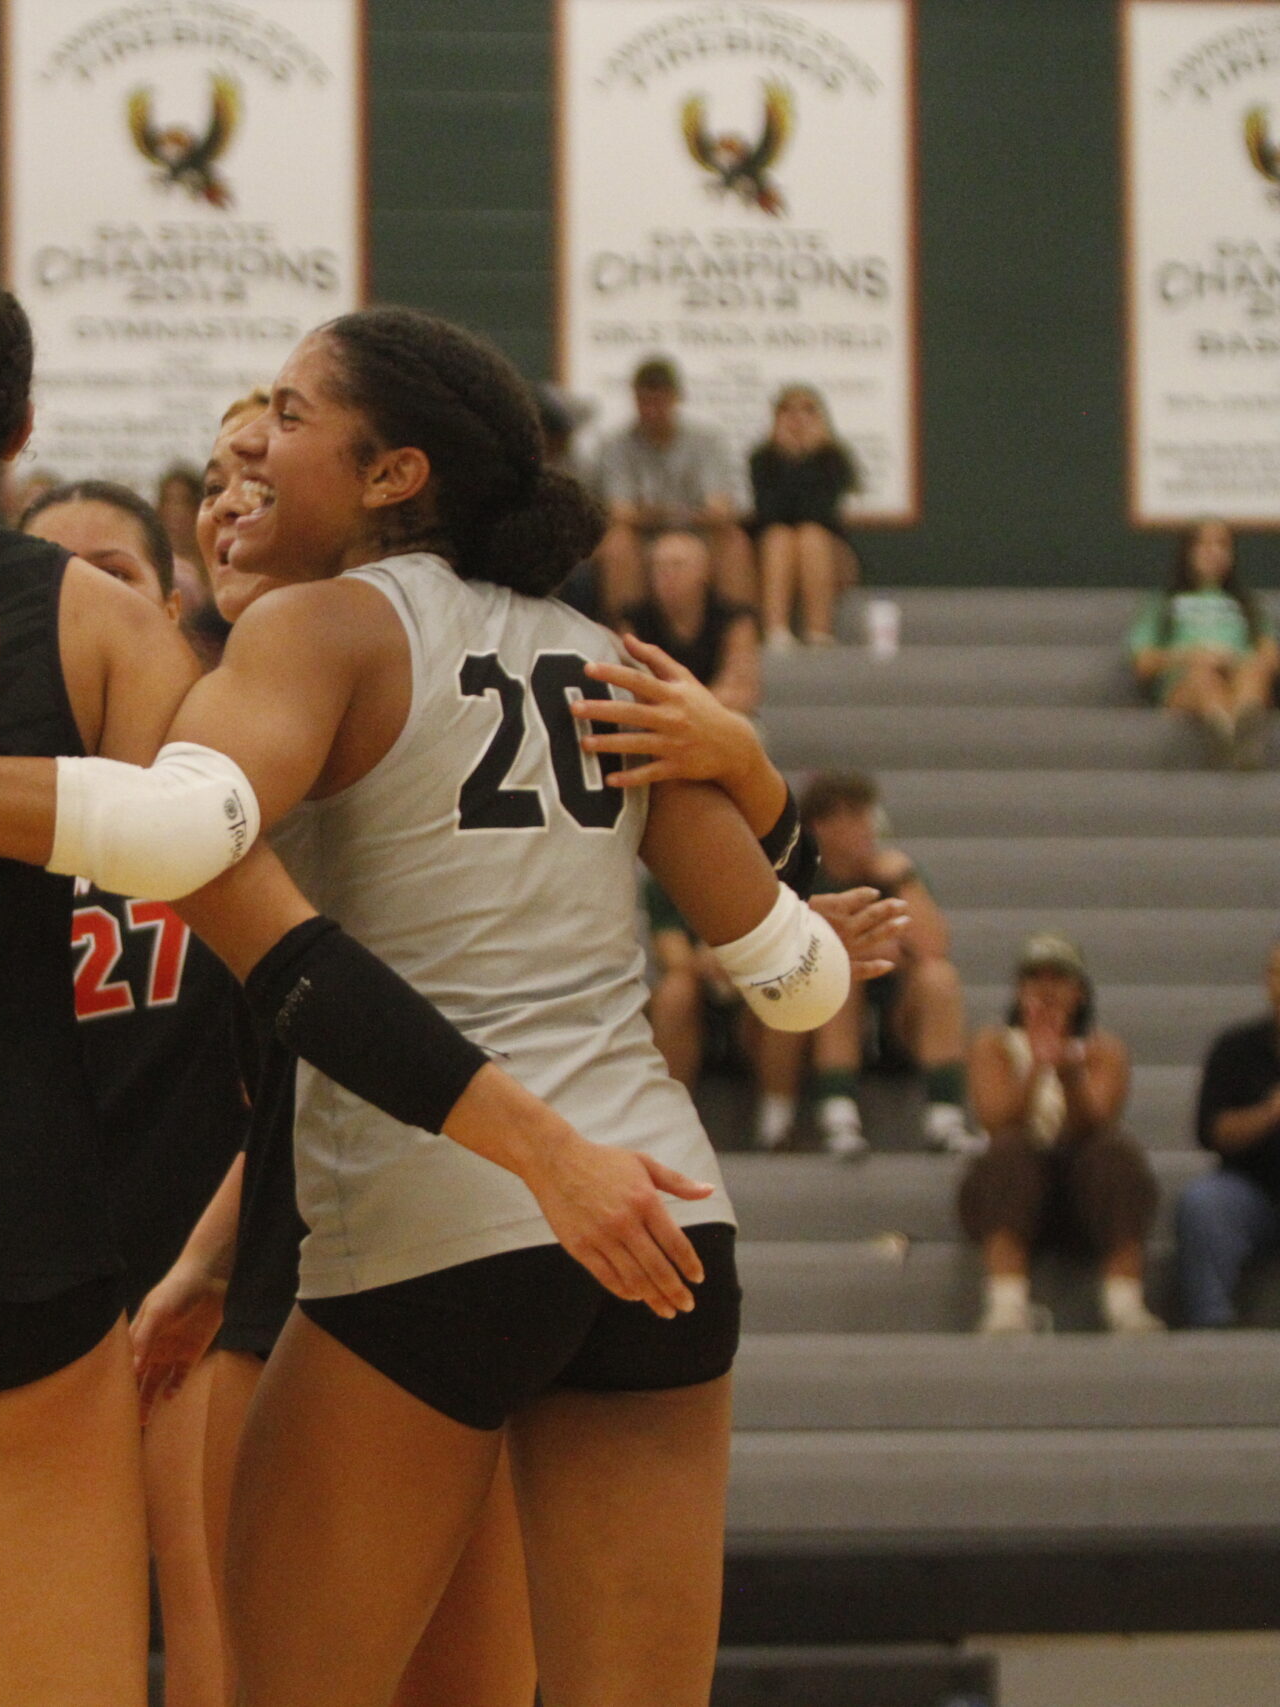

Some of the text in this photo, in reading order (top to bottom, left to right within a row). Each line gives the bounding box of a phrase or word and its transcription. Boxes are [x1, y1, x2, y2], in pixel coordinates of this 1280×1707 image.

[33, 244, 339, 294] CHAMPIONS
[589, 249, 889, 302] CHAMPIONS
[454, 649, 627, 835] 20
[71, 899, 191, 1022] 27
